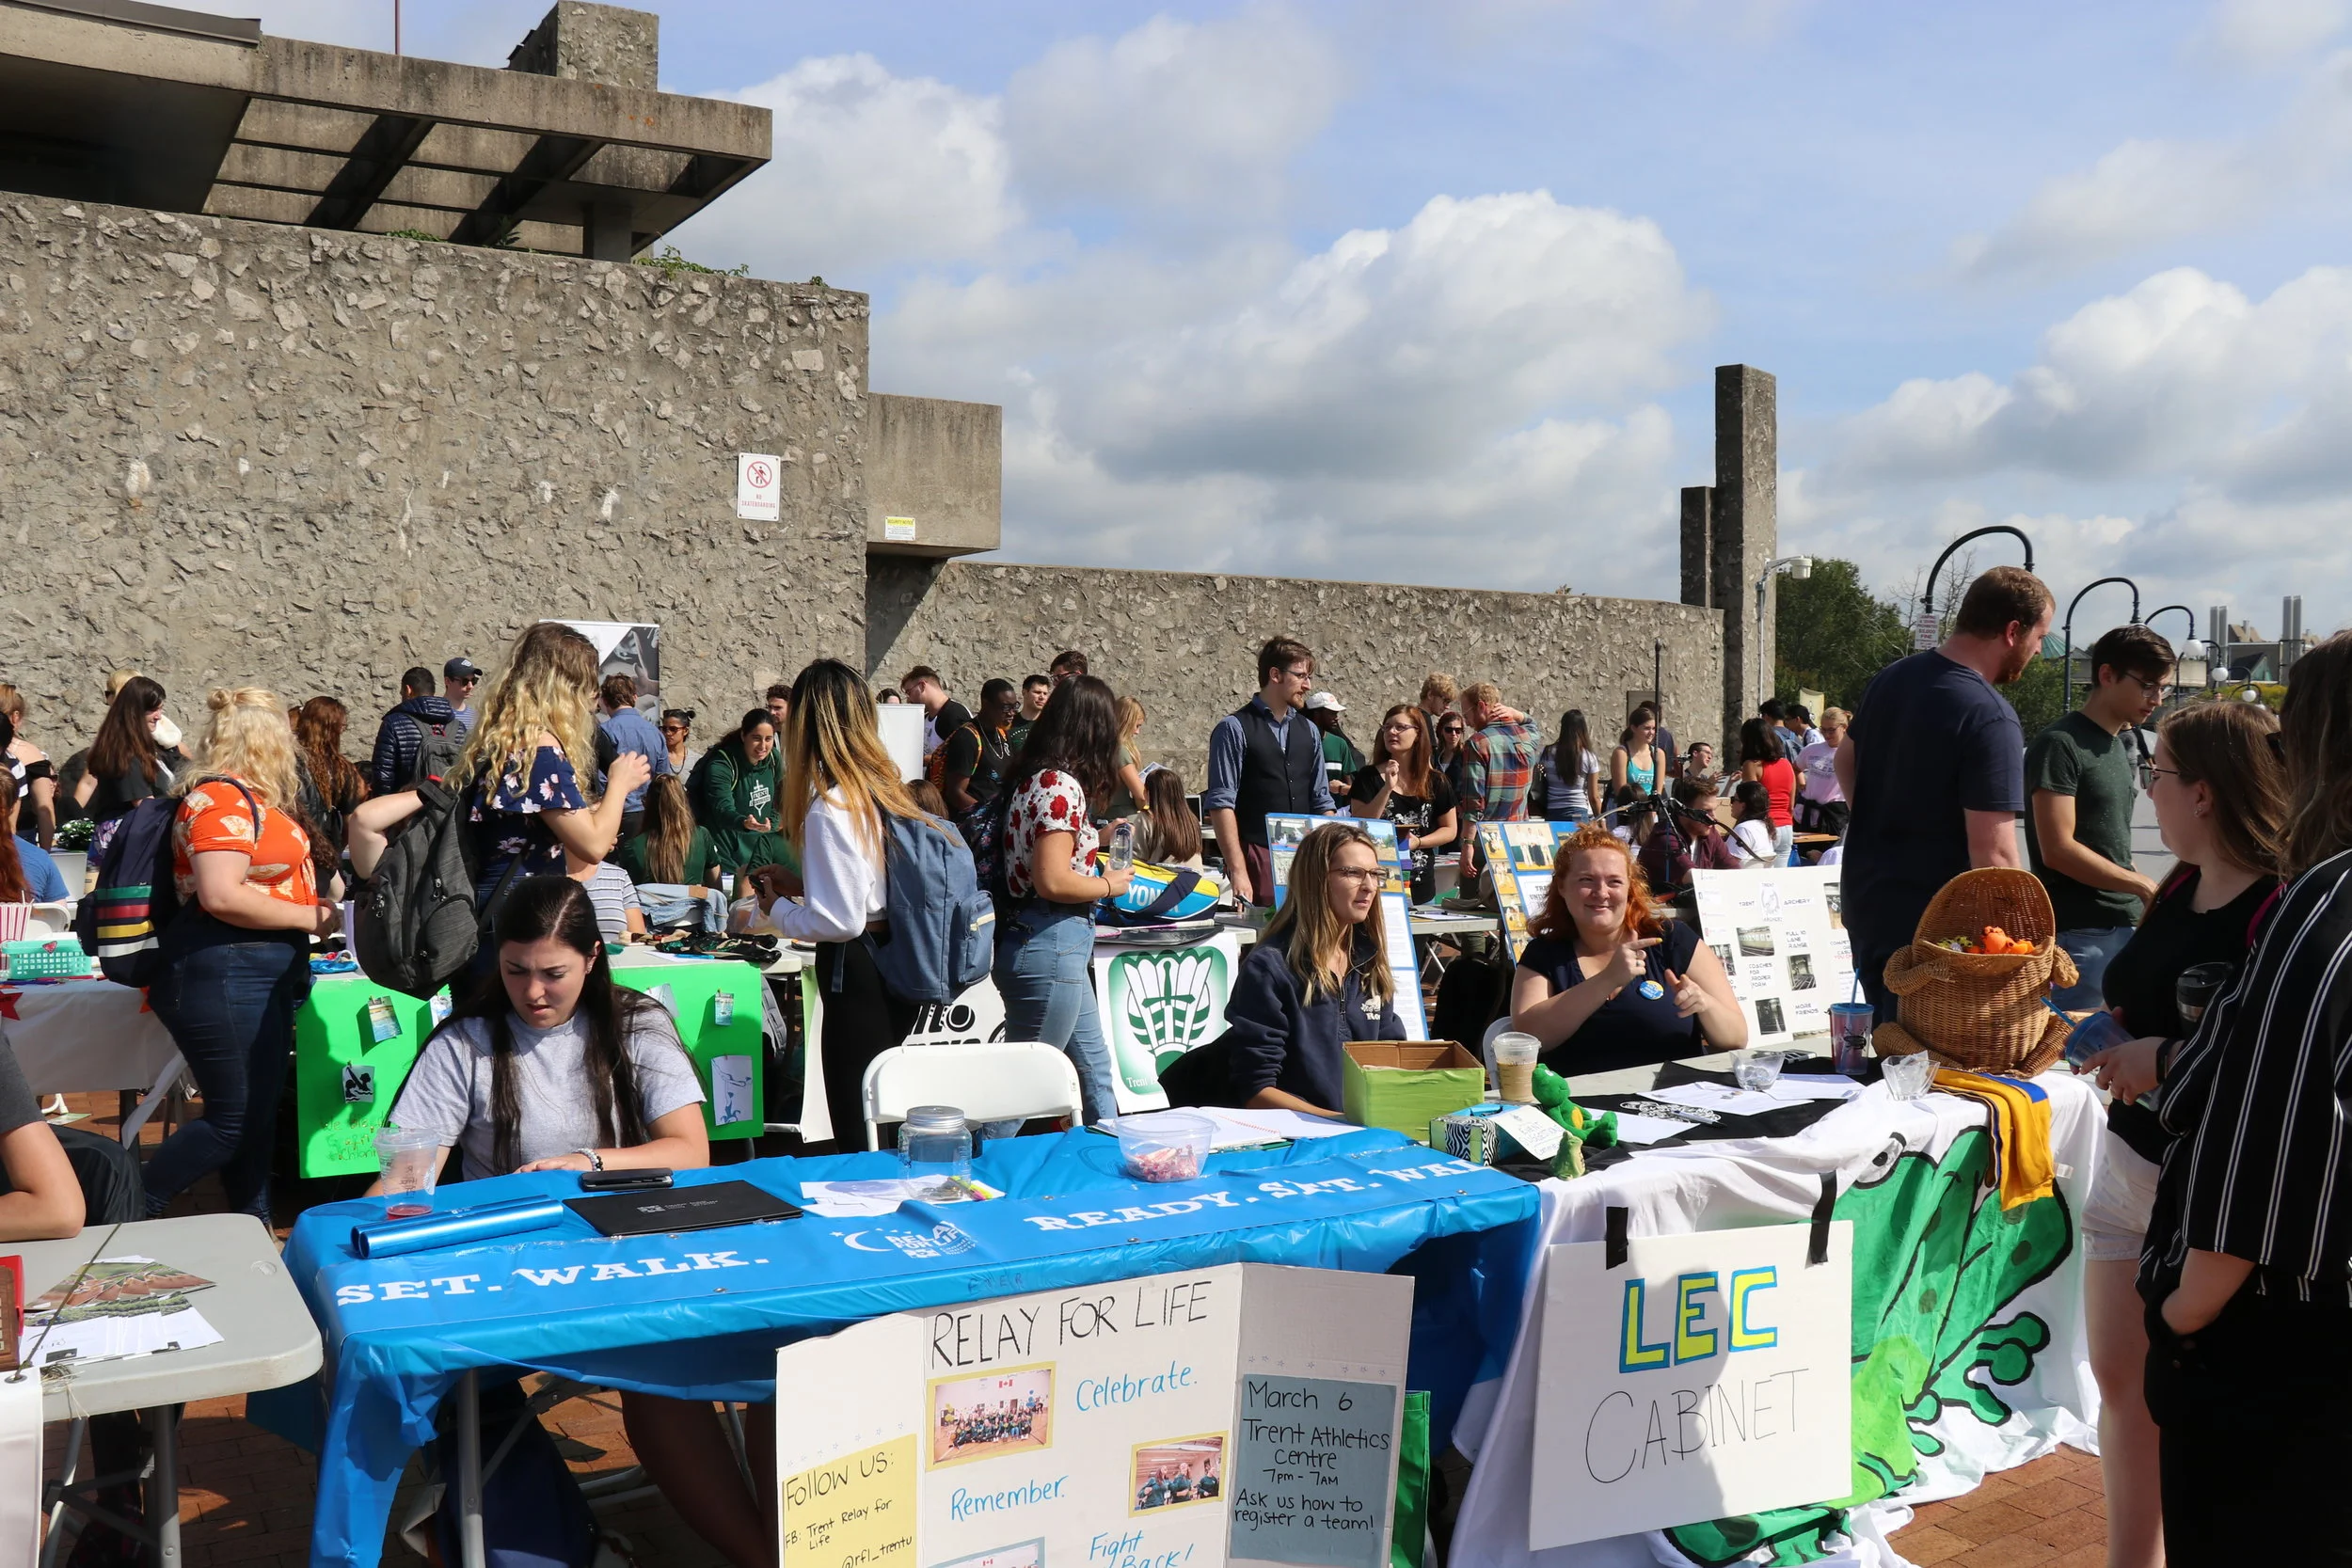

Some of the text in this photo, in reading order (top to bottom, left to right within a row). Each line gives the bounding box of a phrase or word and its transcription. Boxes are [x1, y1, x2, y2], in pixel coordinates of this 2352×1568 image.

[1126, 1077, 1148, 1088] Trent
[1024, 1191, 1260, 1231] READY.
[1367, 1159, 1487, 1182] WAL
[336, 1251, 770, 1307] SET. WALK.
[932, 1281, 1212, 1370] RELAY FOR LIFE
[1619, 1265, 1778, 1373] LEC
[1076, 1361, 1198, 1411] Celebrate.
[1248, 1381, 1352, 1410] March 6
[1243, 1418, 1390, 1450] Trent Athletics
[1585, 1368, 1809, 1483] CABINET
[951, 1475, 1068, 1521] Remember.
[1310, 1471, 1338, 1486] 7AM
[1236, 1488, 1363, 1512] Ask us how to
[785, 1498, 892, 1549] FB: Trent Relay for
[809, 1534, 830, 1550] Life
[1234, 1509, 1374, 1534] register a team!
[1089, 1530, 1144, 1568] Fight
